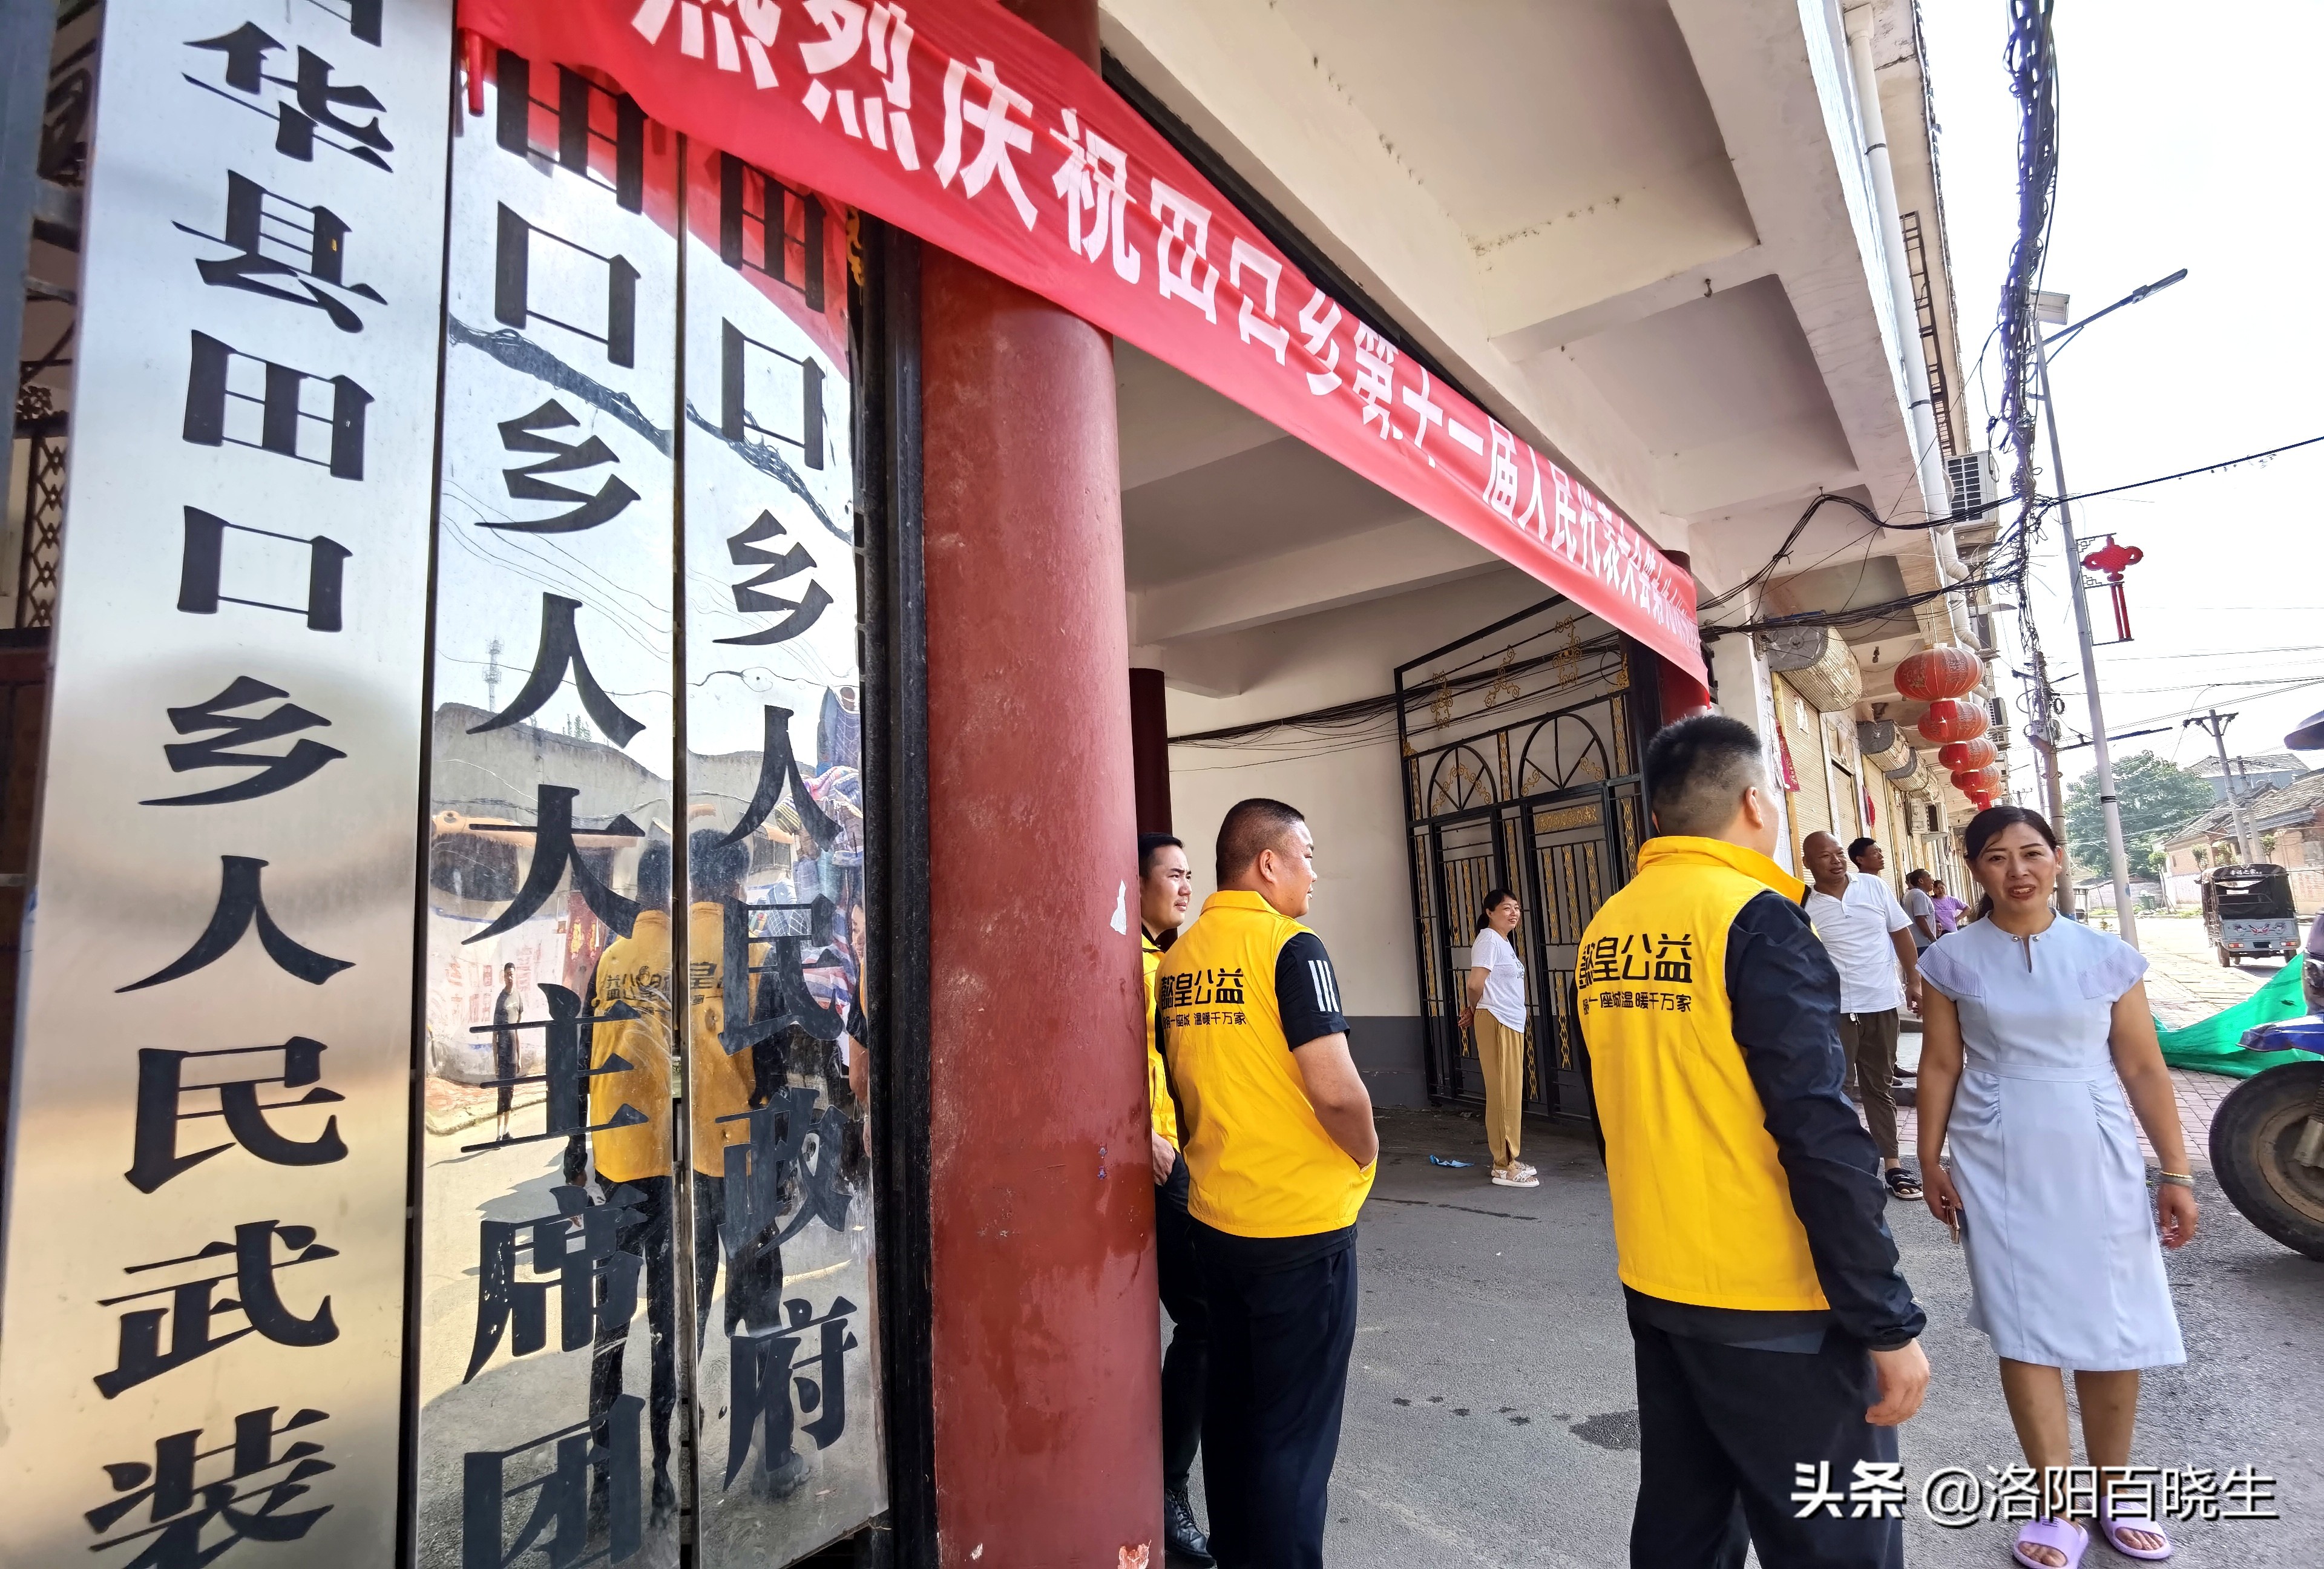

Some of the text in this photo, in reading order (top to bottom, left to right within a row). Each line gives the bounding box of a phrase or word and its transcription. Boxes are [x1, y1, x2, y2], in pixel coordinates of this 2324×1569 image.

[84, 0, 394, 1569] 华县田口乡人民武装
[712, 150, 857, 1491] 田口乡人民政府
